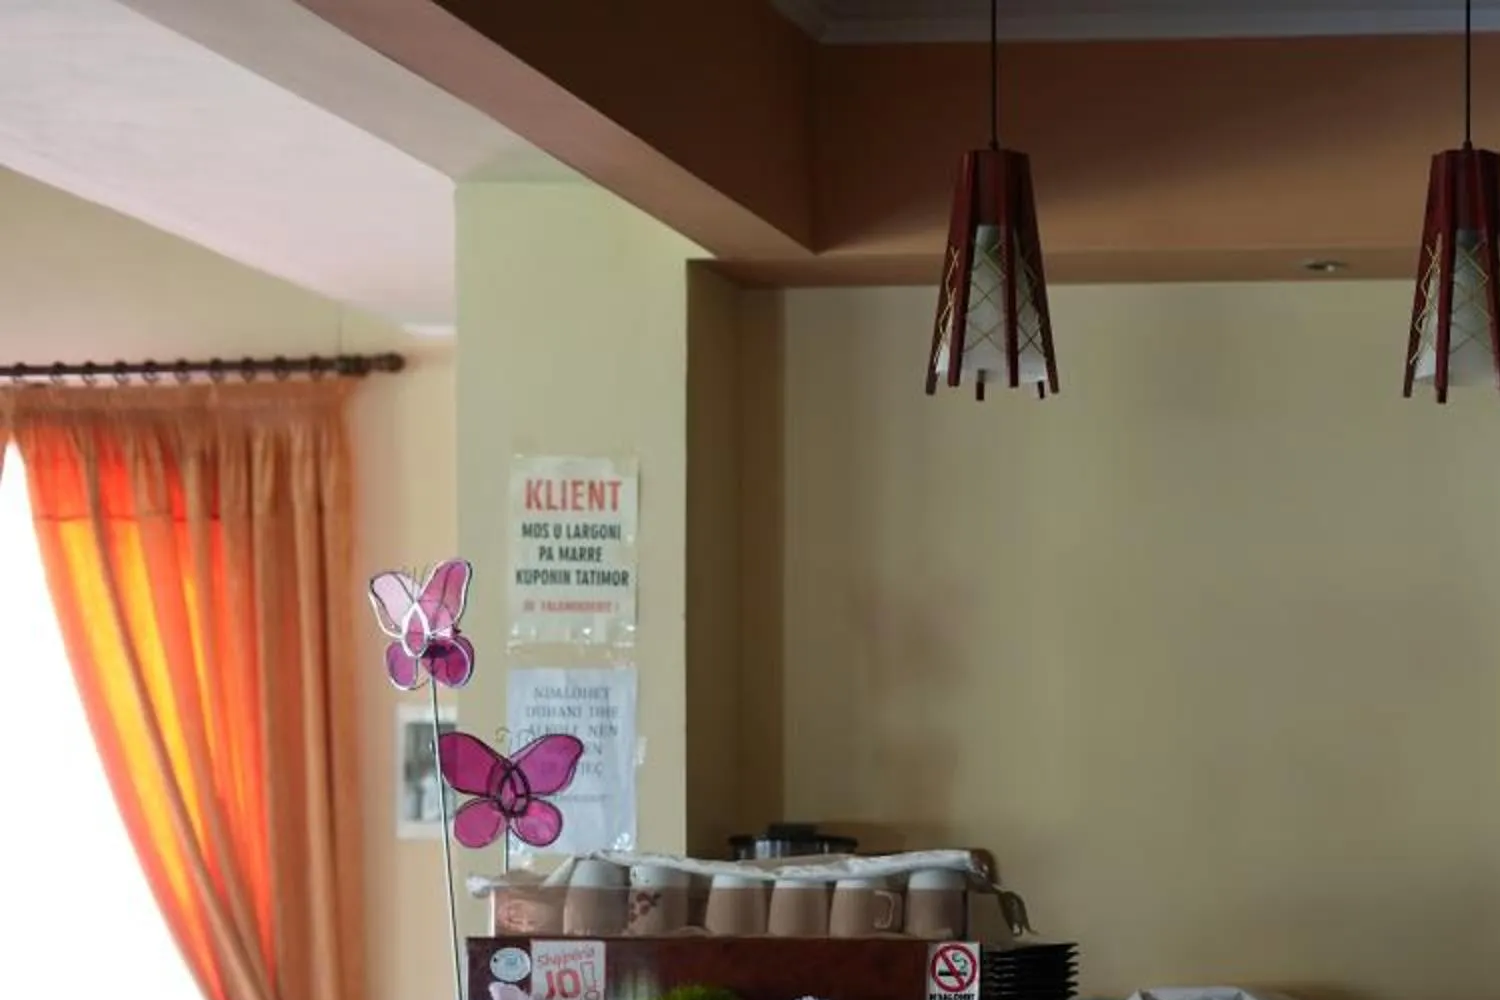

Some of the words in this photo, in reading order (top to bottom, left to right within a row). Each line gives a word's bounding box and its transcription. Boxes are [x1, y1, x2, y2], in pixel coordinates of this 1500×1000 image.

[525, 479, 622, 512] KLIENT
[521, 522, 549, 539] MOS
[553, 523, 563, 540] U
[566, 524, 621, 540] LARGONI
[539, 546, 554, 561] PA
[516, 569, 571, 585] KUPONIN
[576, 569, 630, 587] TATIMOR
